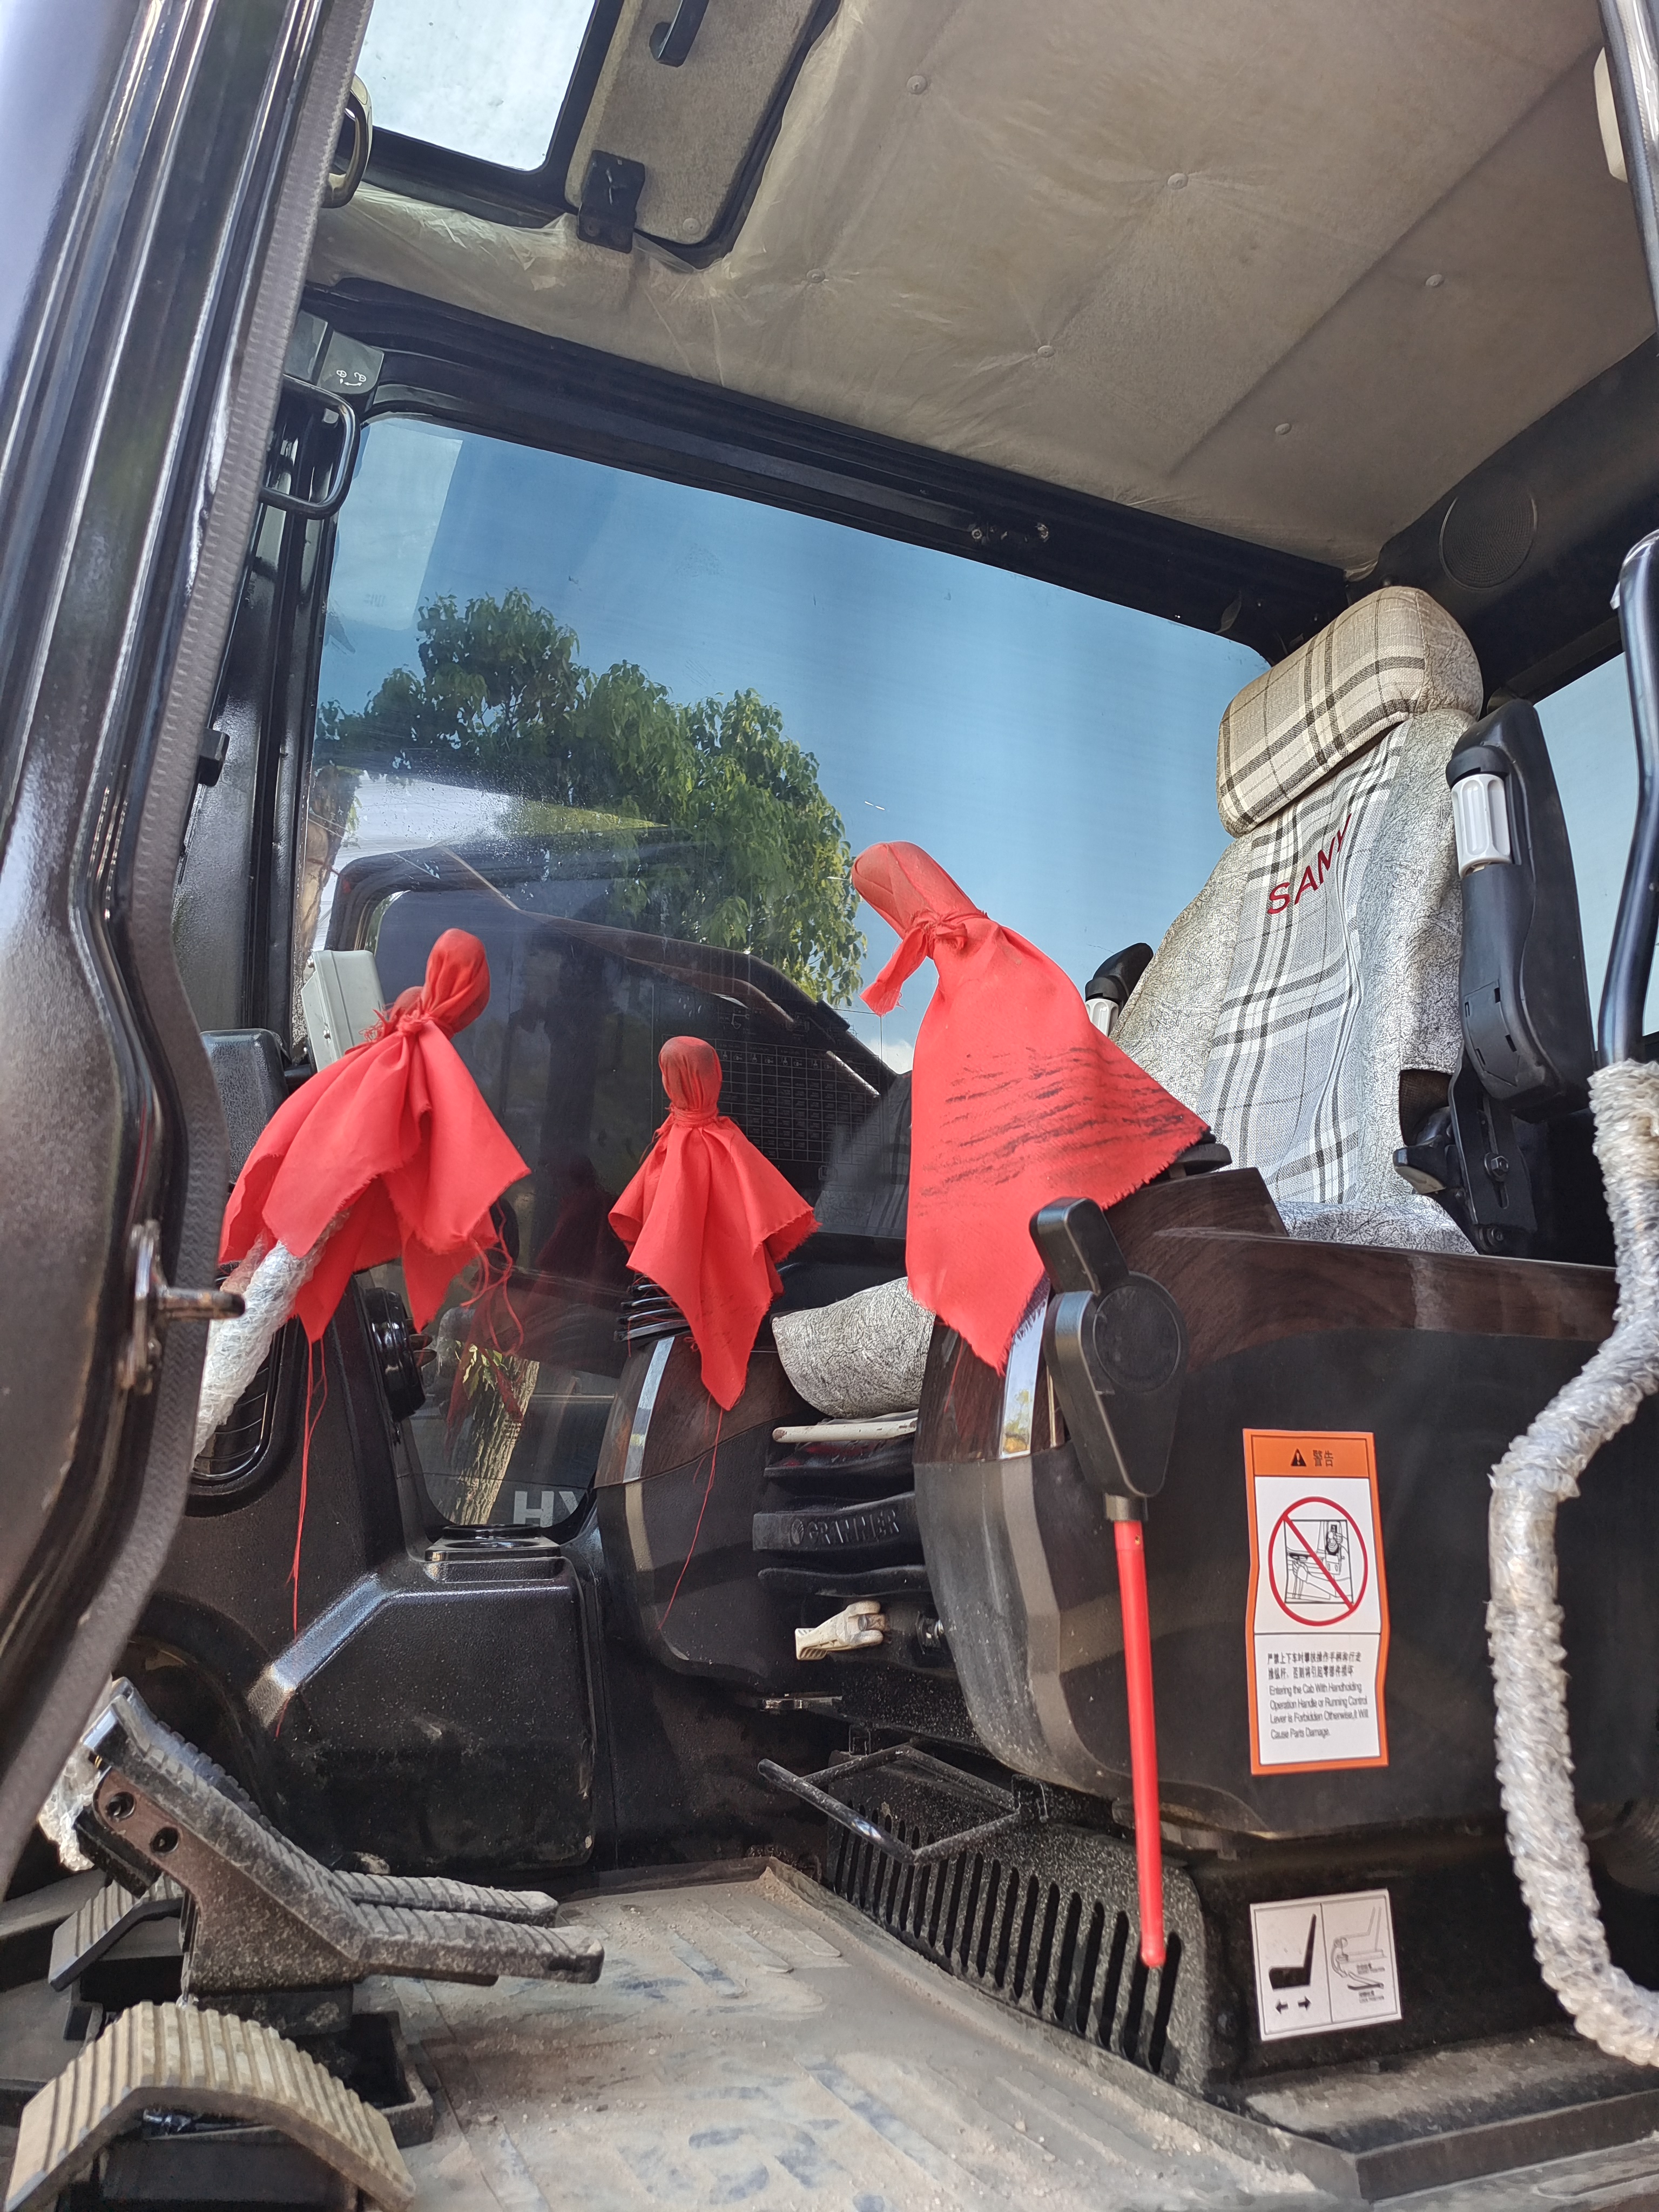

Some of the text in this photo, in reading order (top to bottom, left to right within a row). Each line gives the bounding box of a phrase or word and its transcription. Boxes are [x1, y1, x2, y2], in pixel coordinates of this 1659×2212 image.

[1267, 813, 1352, 914] SANY
[1313, 1449, 1334, 1467] 警告
[1269, 1685, 1292, 1697] Entering
[1293, 1685, 1301, 1694] the
[1303, 1683, 1314, 1694] Cab
[1315, 1682, 1327, 1692] With
[1270, 1700, 1296, 1711] Operation
[1298, 1698, 1317, 1708] Handle
[1325, 1697, 1347, 1708] Running
[1348, 1695, 1367, 1706] Control
[1270, 1714, 1286, 1724] Lever
[1287, 1713, 1292, 1723] is
[1358, 1709, 1368, 1718] Will
[1271, 1729, 1289, 1739] Cause
[1290, 1728, 1304, 1738] Parts
